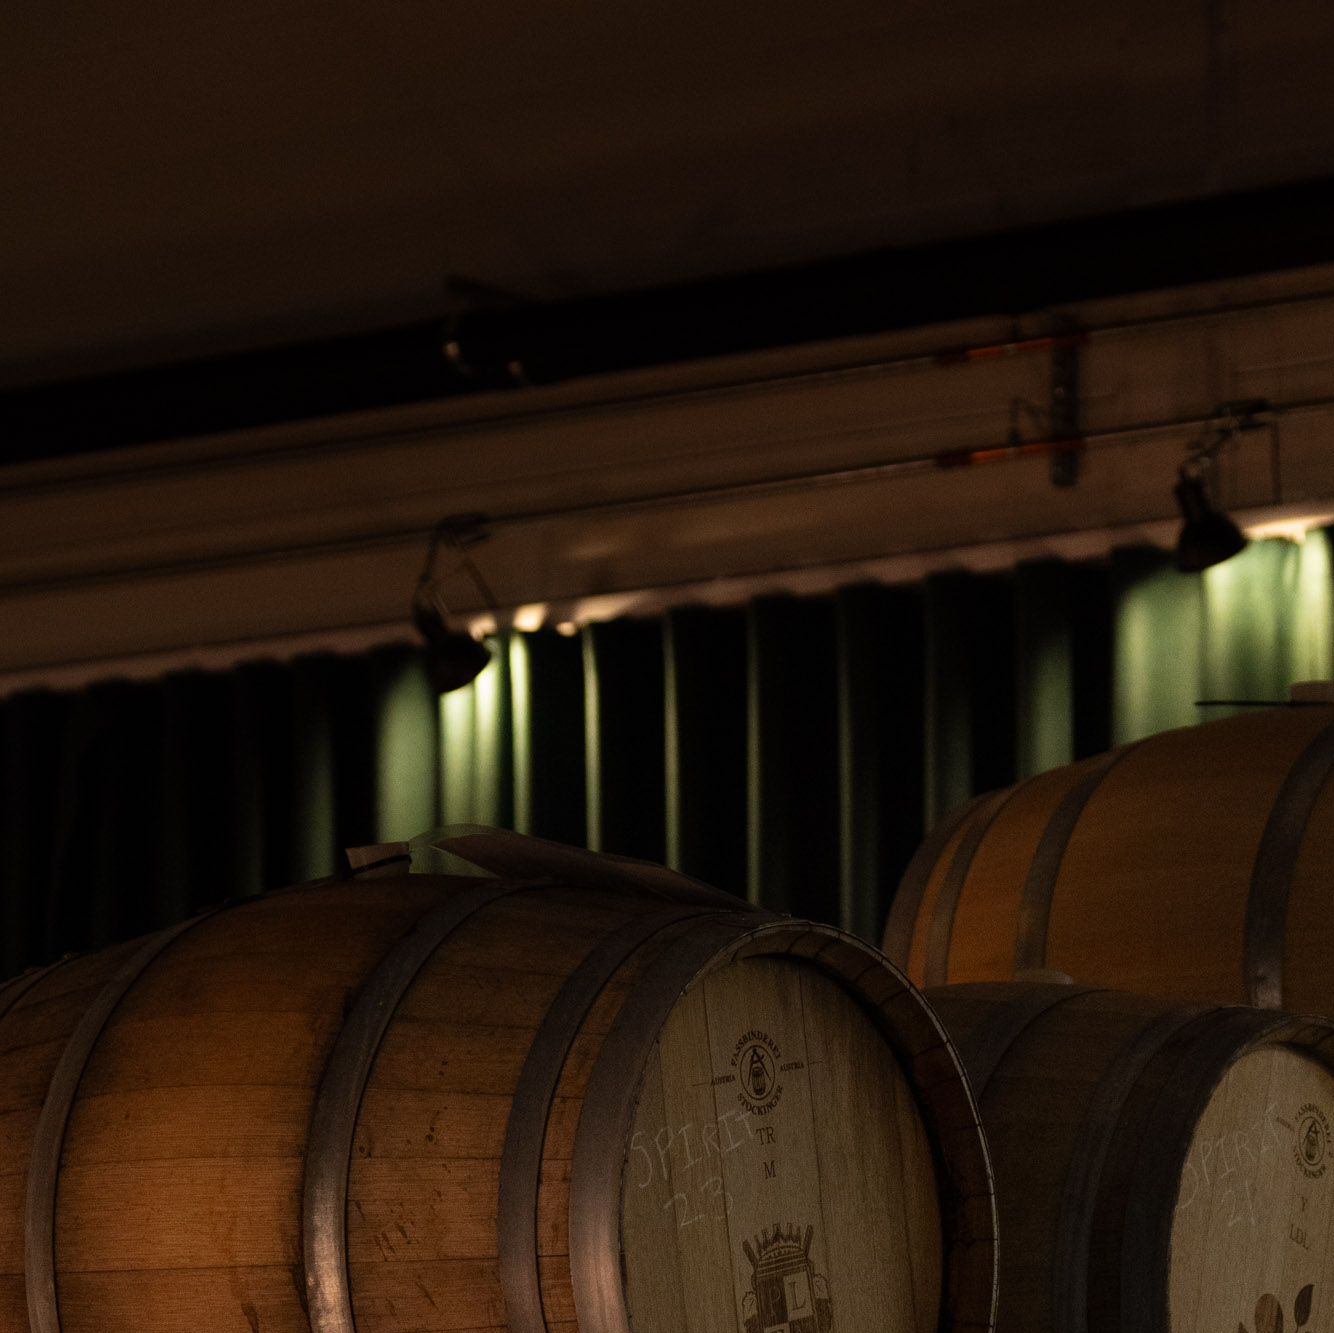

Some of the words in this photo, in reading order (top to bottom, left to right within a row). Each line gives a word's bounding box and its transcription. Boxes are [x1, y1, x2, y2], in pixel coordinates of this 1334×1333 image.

[731, 1030, 781, 1067] FASSBINDEREI
[737, 1085, 784, 1116] STOCKINGER
[630, 1109, 755, 1189] SPIRIT
[756, 1126, 776, 1146] TR
[763, 1160, 776, 1179] M
[663, 1176, 734, 1228] 23
